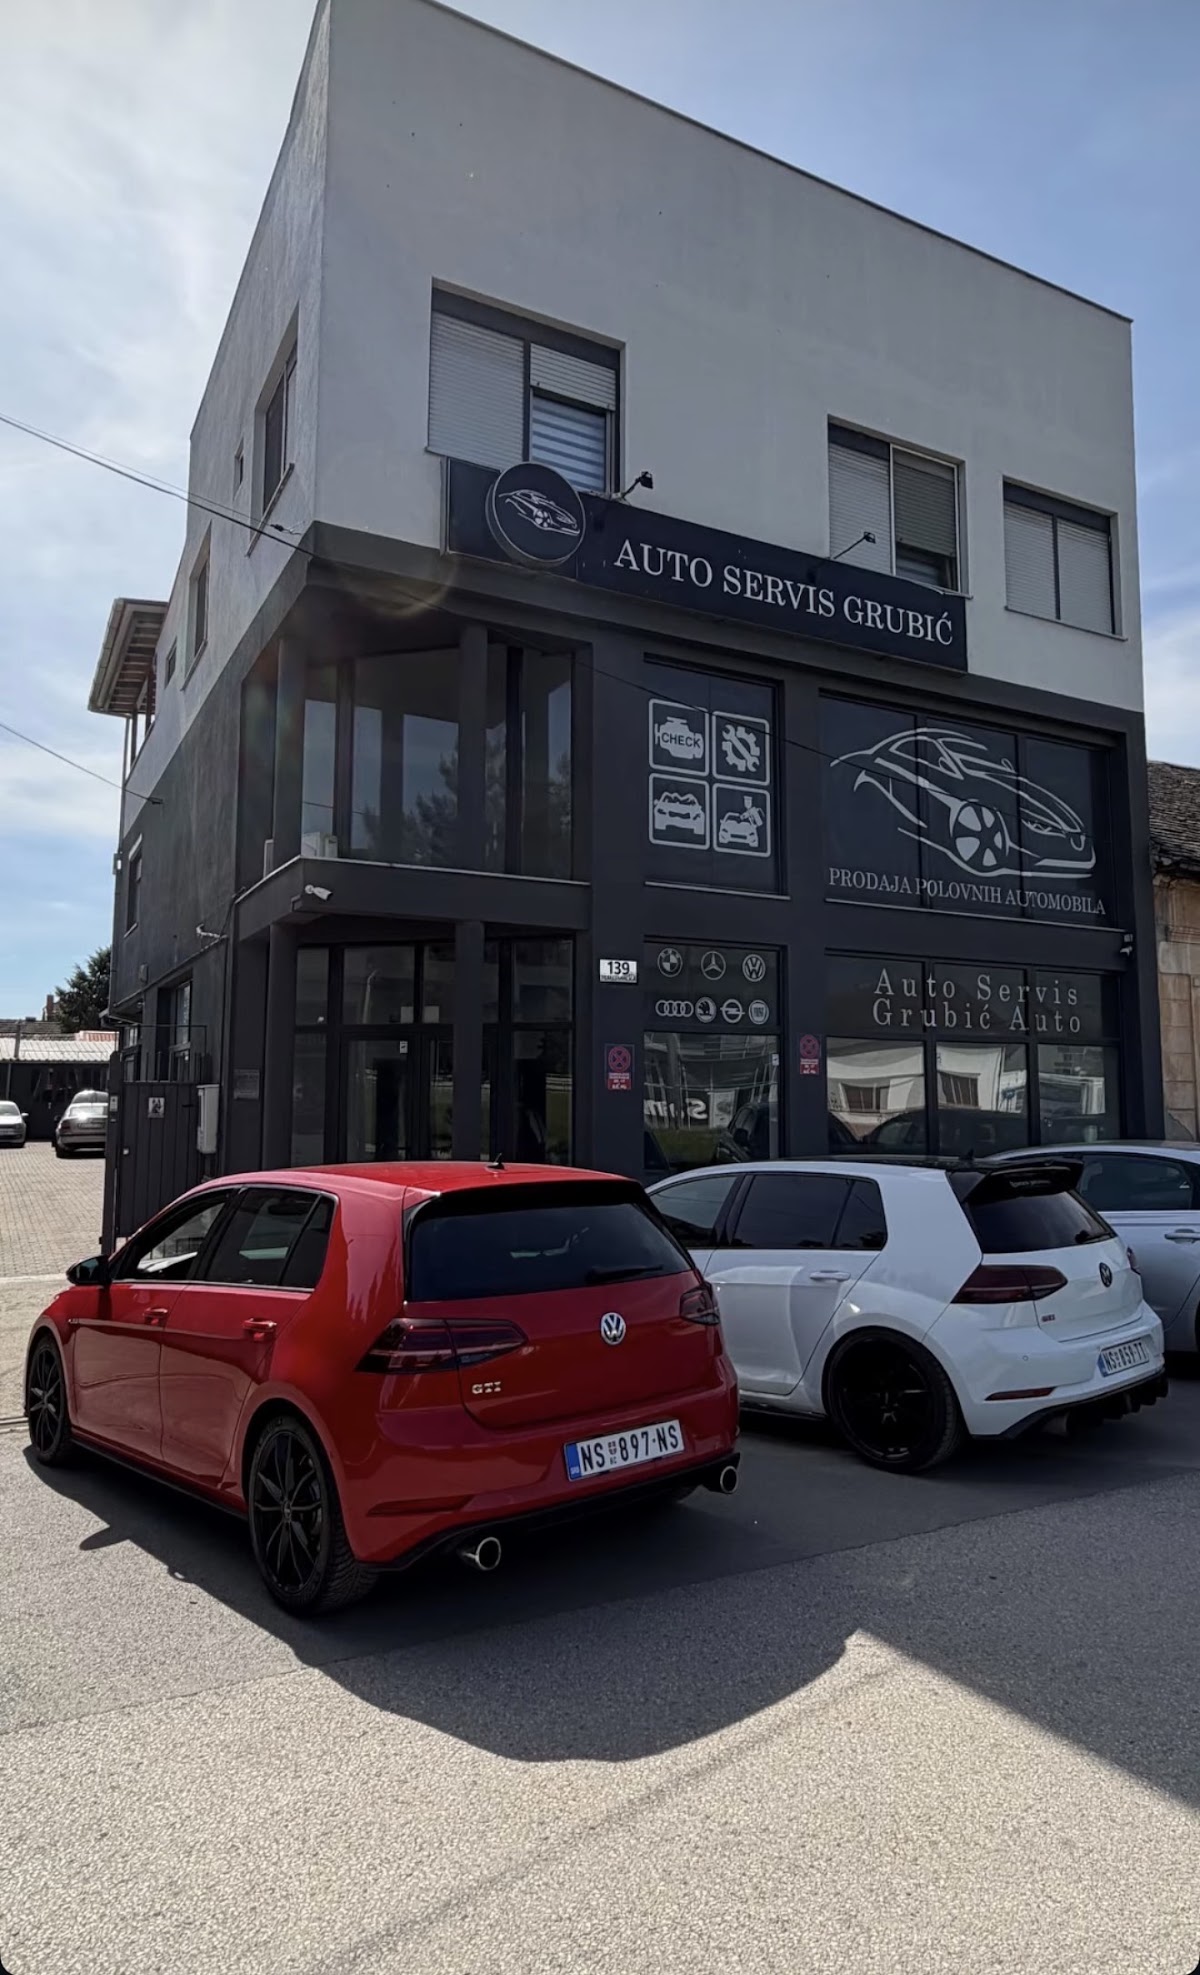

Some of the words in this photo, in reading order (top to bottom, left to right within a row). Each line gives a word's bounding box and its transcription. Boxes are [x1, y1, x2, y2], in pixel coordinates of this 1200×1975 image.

[613, 538, 713, 587] AUTO
[723, 565, 835, 617] SERVIS
[843, 596, 953, 646] GRUBIĆ
[661, 732, 701, 749] CHECK
[829, 867, 913, 894] PRODAJA
[915, 878, 1002, 904] POLOVNIH
[1005, 890, 1106, 915] AUTOMOBILA
[607, 961, 630, 975] 139
[874, 968, 956, 999] Auto
[977, 974, 1079, 1005] Servis
[873, 997, 991, 1030] Grubić
[1009, 1005, 1082, 1034] Auto
[1103, 1351, 1117, 1371] NS
[471, 1381, 501, 1395] GTI
[580, 1442, 605, 1472] NS
